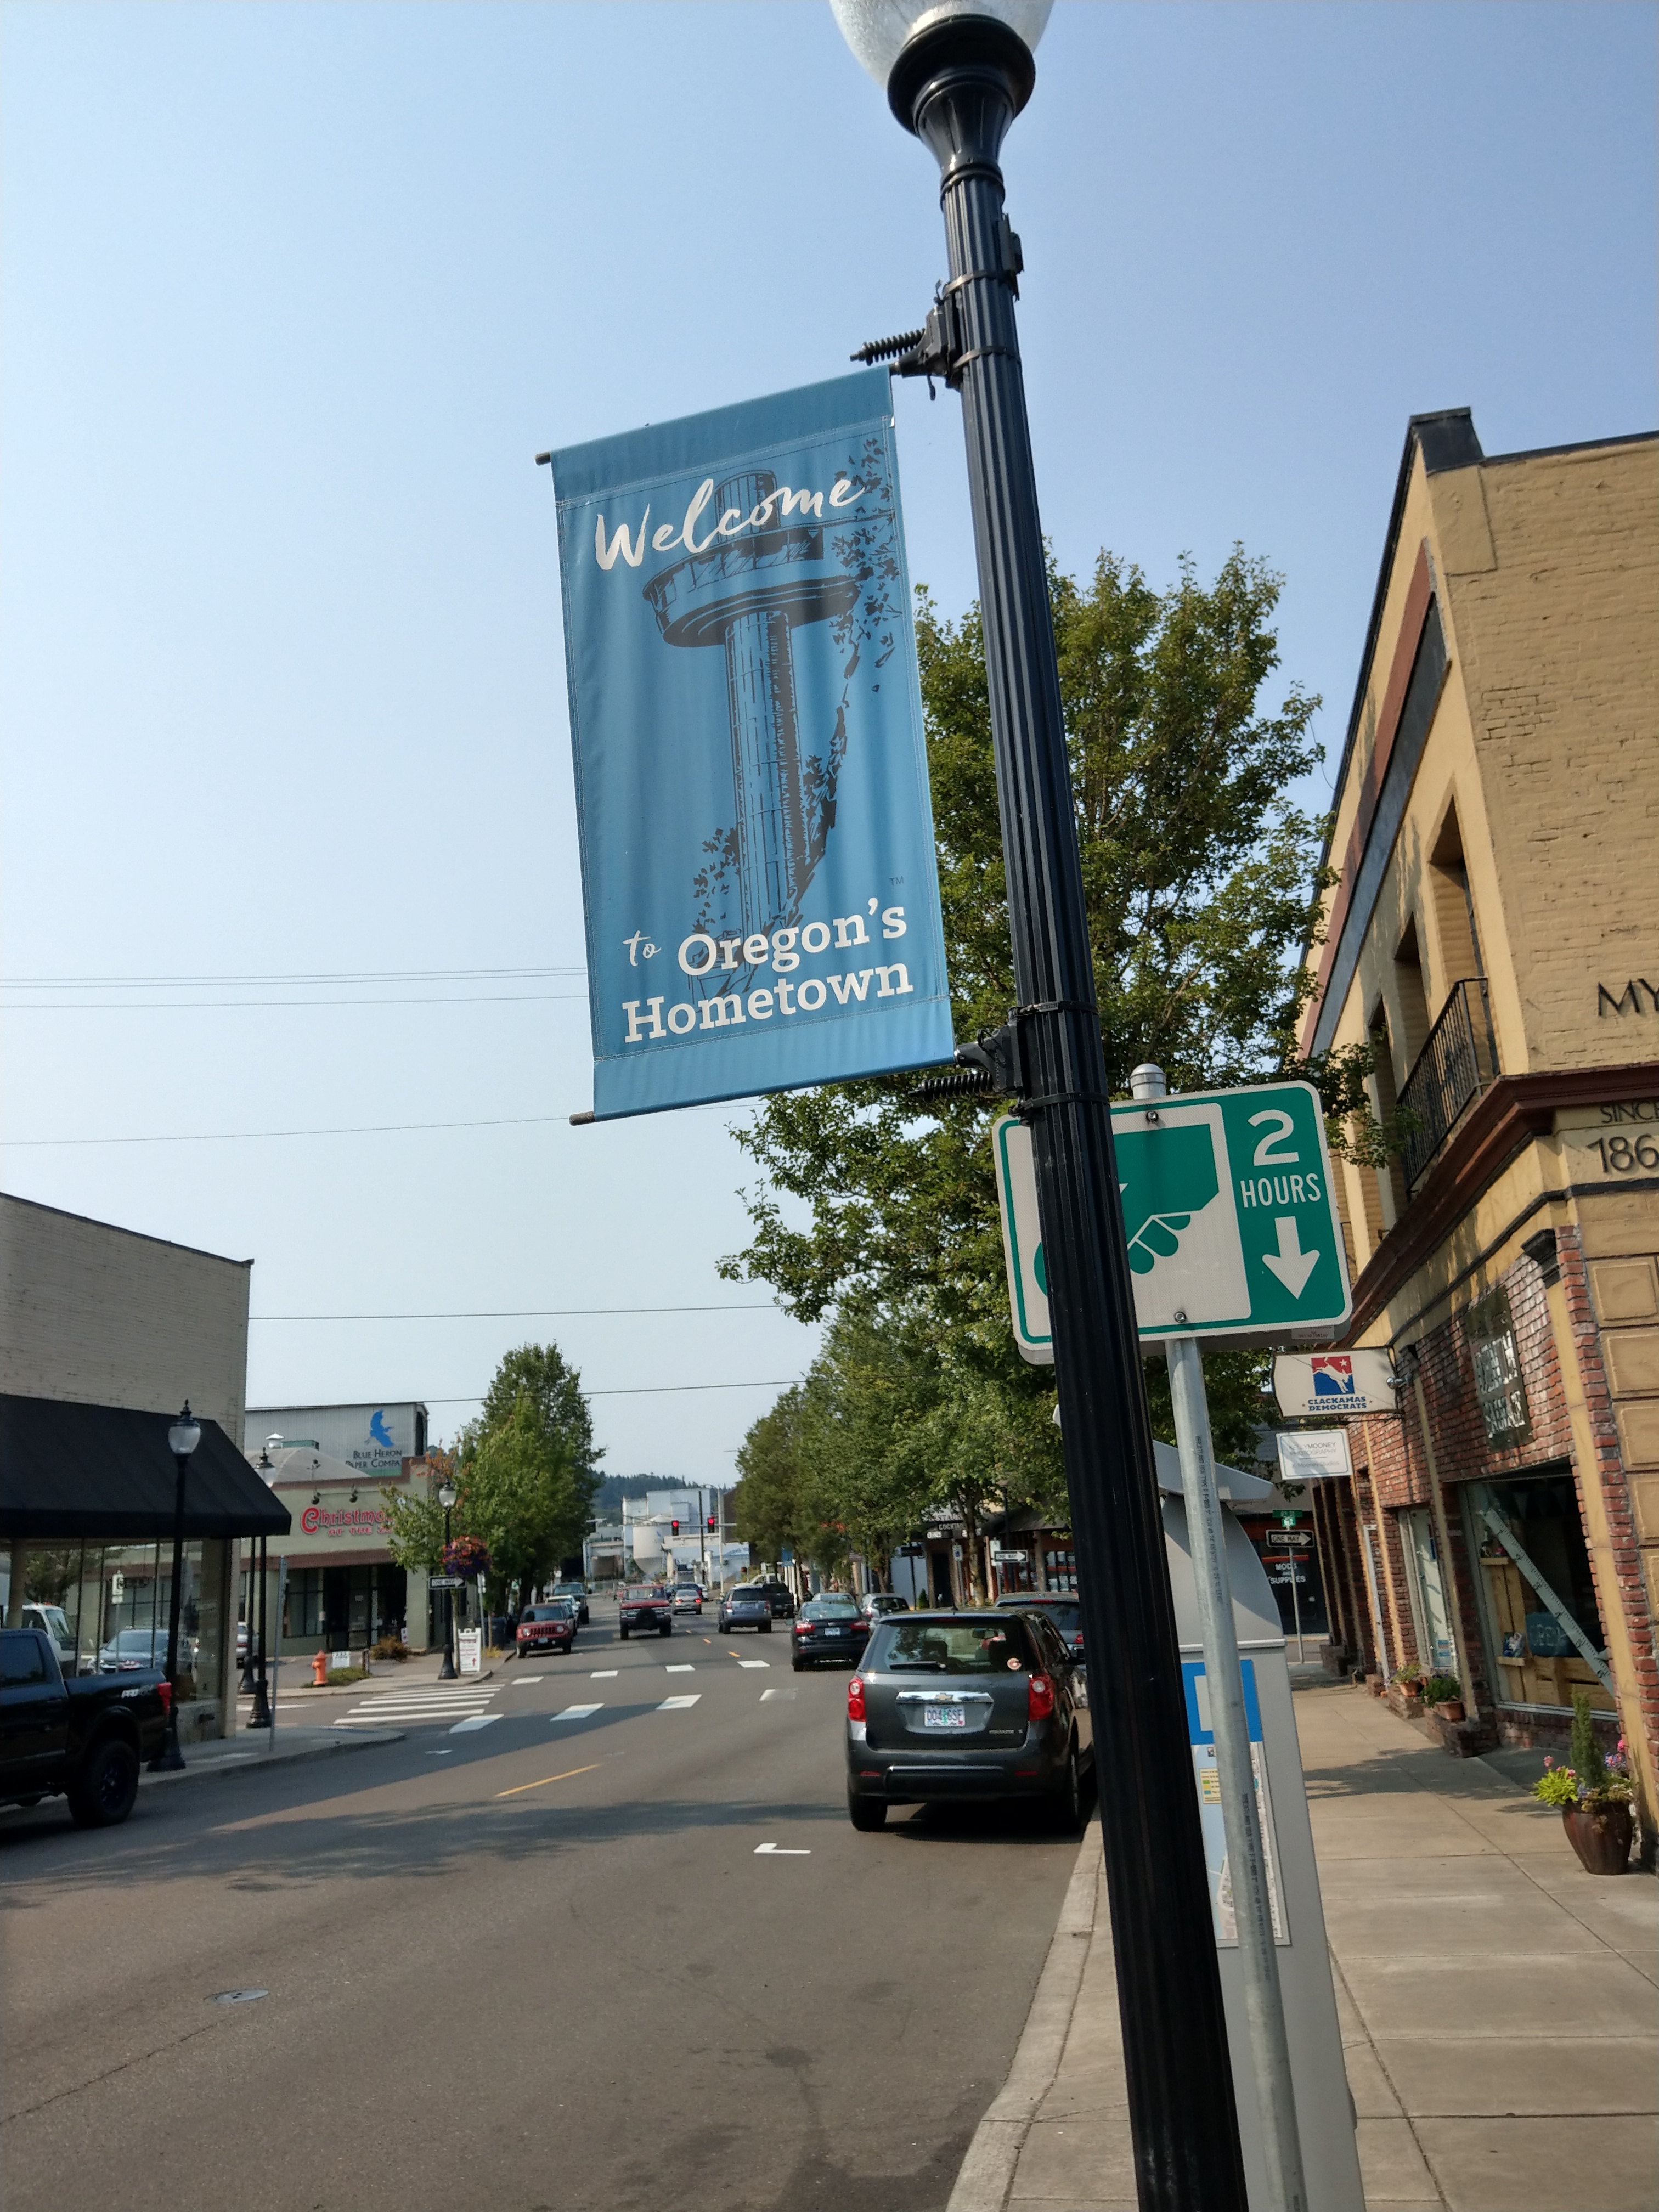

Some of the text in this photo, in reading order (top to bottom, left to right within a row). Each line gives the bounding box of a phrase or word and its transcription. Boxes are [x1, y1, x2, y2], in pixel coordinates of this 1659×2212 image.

[595, 477, 865, 571] Welcome
[889, 876, 904, 886] TM
[622, 897, 907, 976] to Oregon's
[622, 962, 913, 1043] Hometown
[1246, 1109, 1299, 1167] 2
[1240, 1172, 1321, 1209] HOURS
[1307, 1396, 1366, 1405] CLACKAMAS
[1308, 1403, 1367, 1412] DEMOCRATS
[353, 1449, 402, 1459] BLUE HERON
[350, 1526, 373, 1536] THE
[1270, 1575, 1306, 1584] SUPPLES
